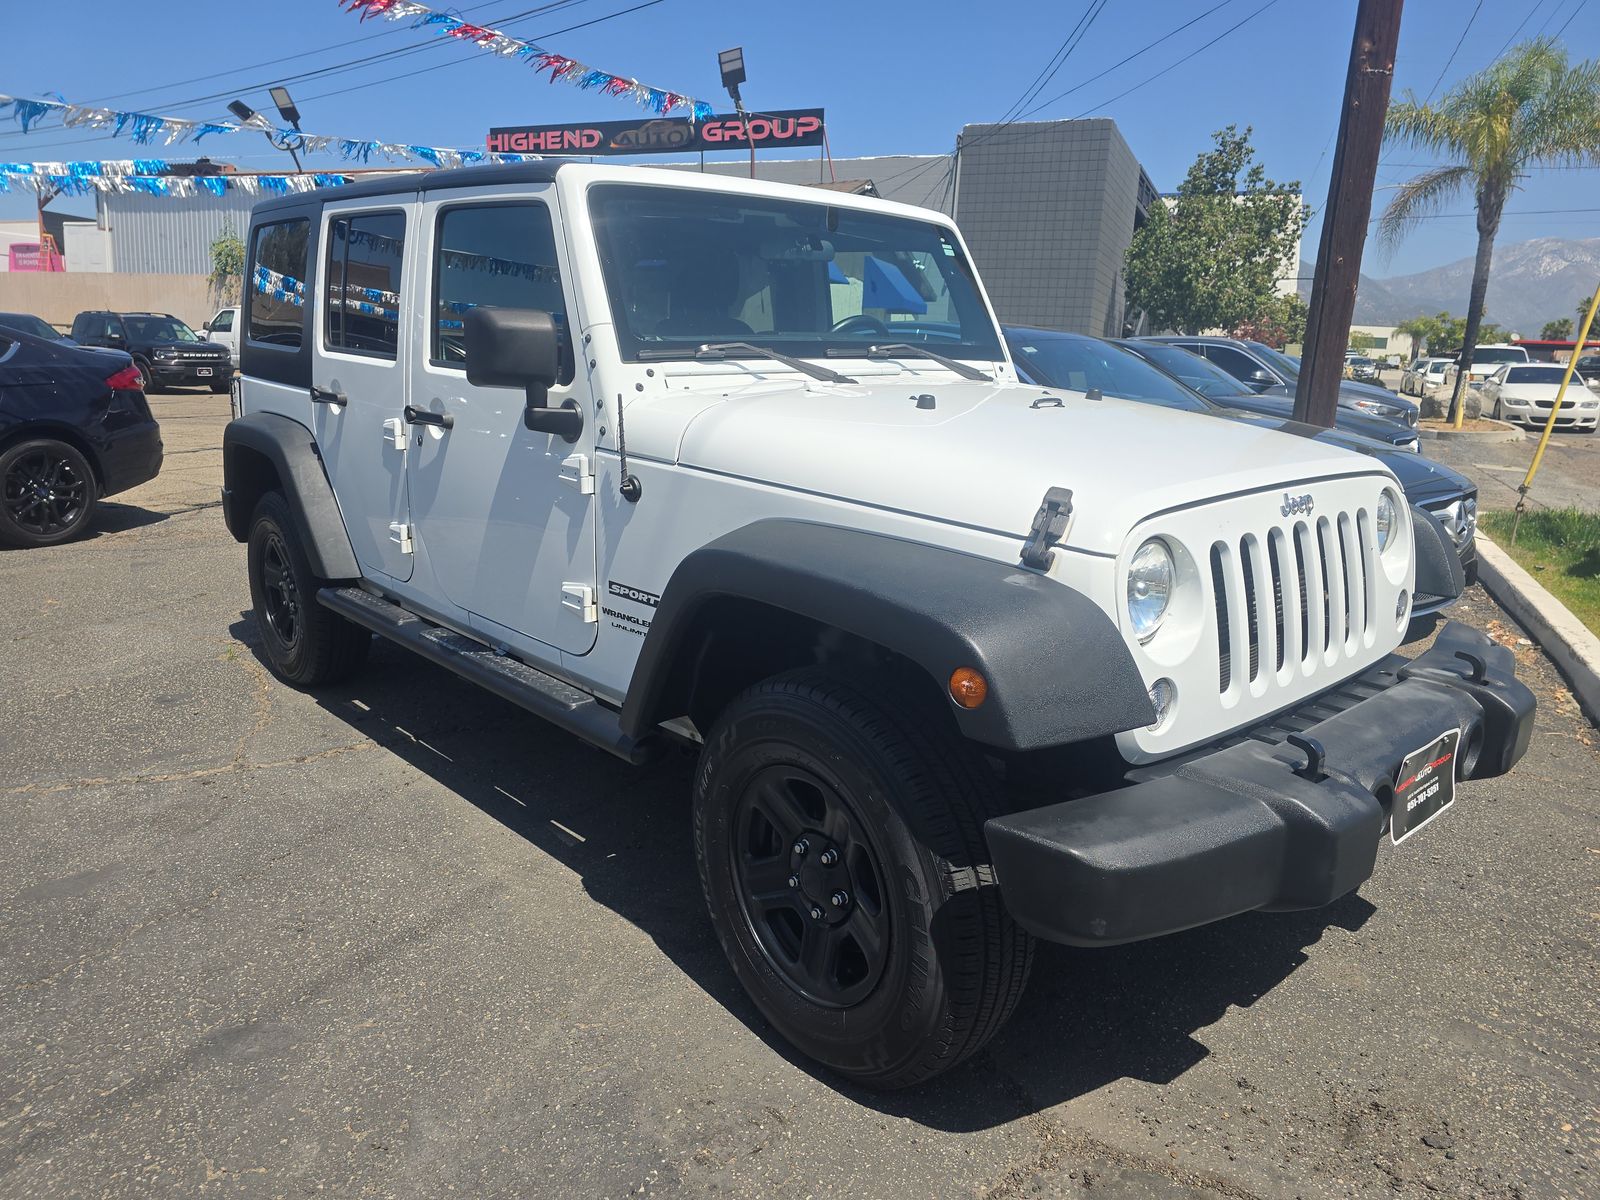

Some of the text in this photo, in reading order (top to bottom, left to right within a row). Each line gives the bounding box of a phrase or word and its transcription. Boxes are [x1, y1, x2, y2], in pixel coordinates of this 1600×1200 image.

[486, 116, 820, 152] HIGHEND AUTO GROUP
[1280, 493, 1314, 517] Jeep
[609, 584, 657, 605] SPORT
[602, 606, 650, 627] WRANGLE
[1415, 766, 1432, 782] AUTO
